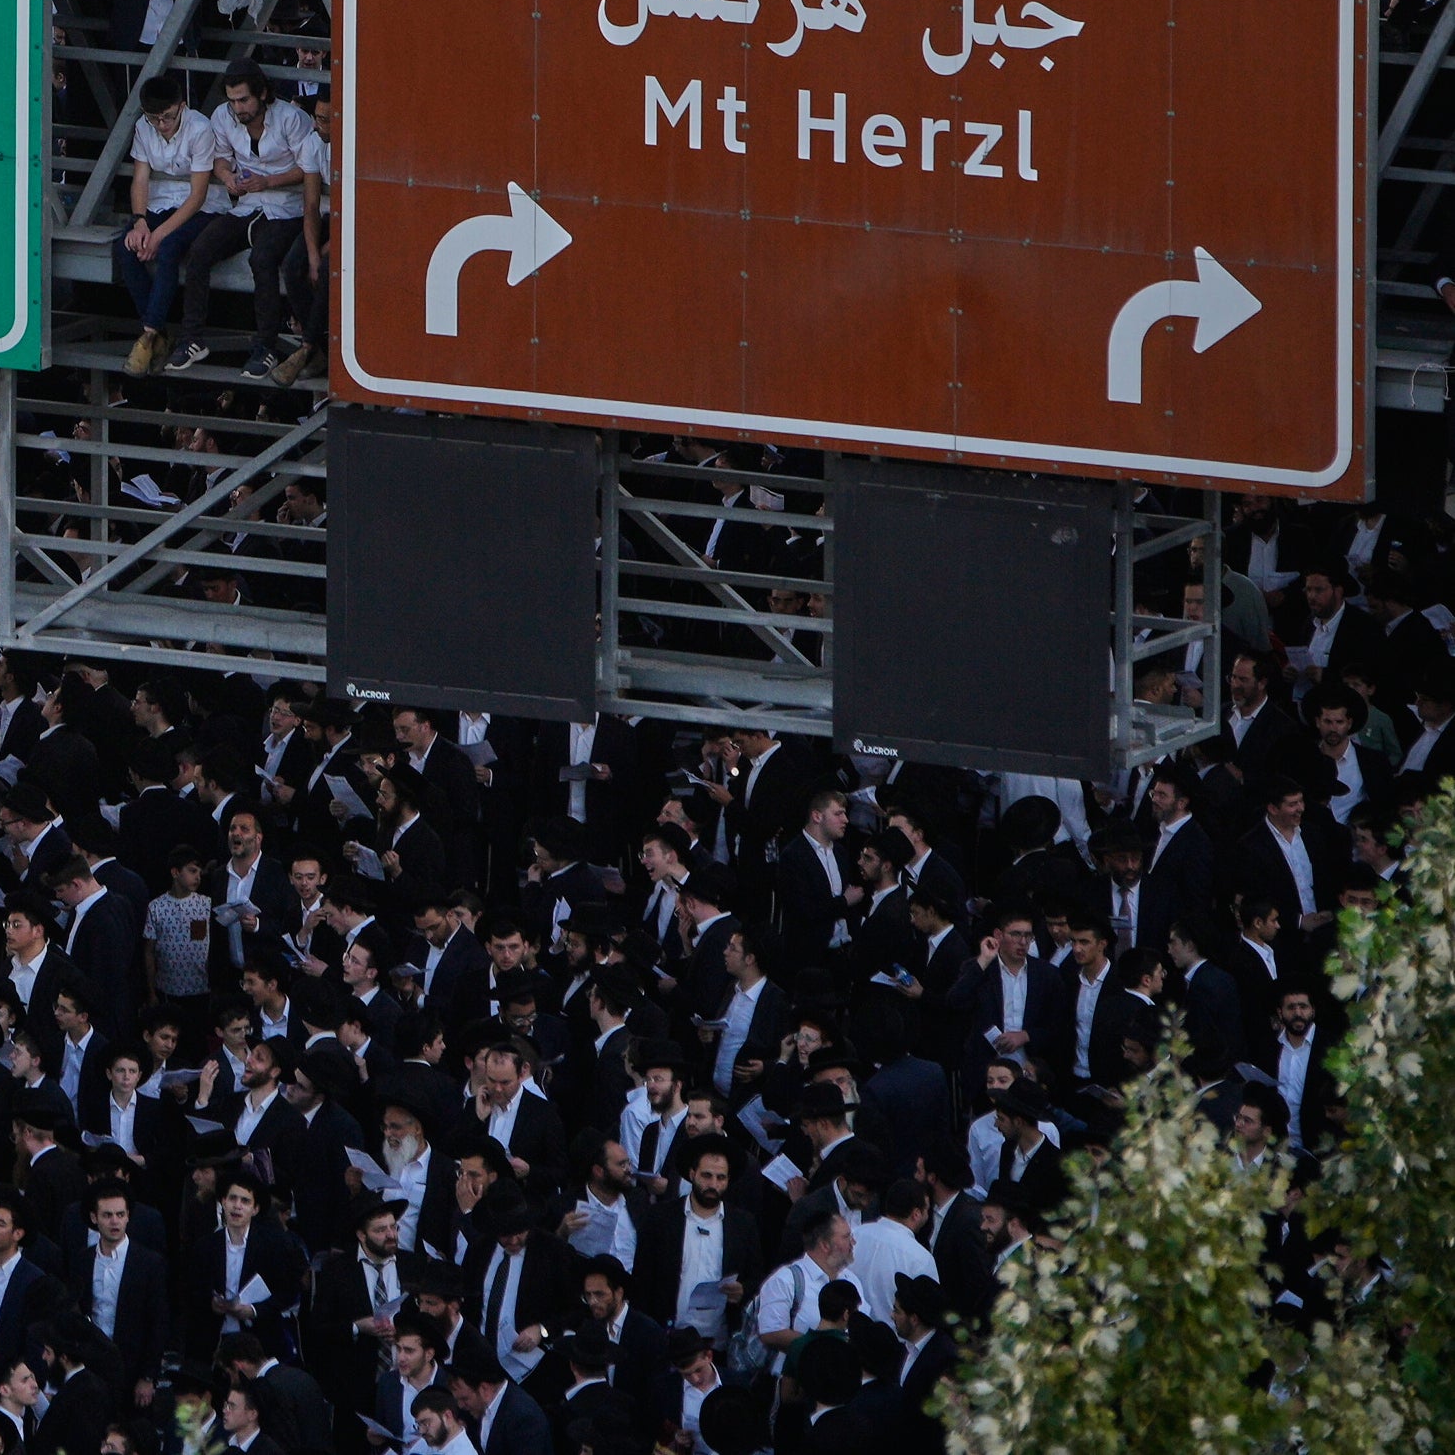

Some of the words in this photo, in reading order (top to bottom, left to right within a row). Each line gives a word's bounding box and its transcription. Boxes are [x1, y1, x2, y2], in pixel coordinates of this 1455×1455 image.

[644, 75, 747, 154] Mt
[798, 89, 1039, 182] Herzl
[356, 689, 391, 701] LACROIX
[863, 746, 898, 757] LACROIX
